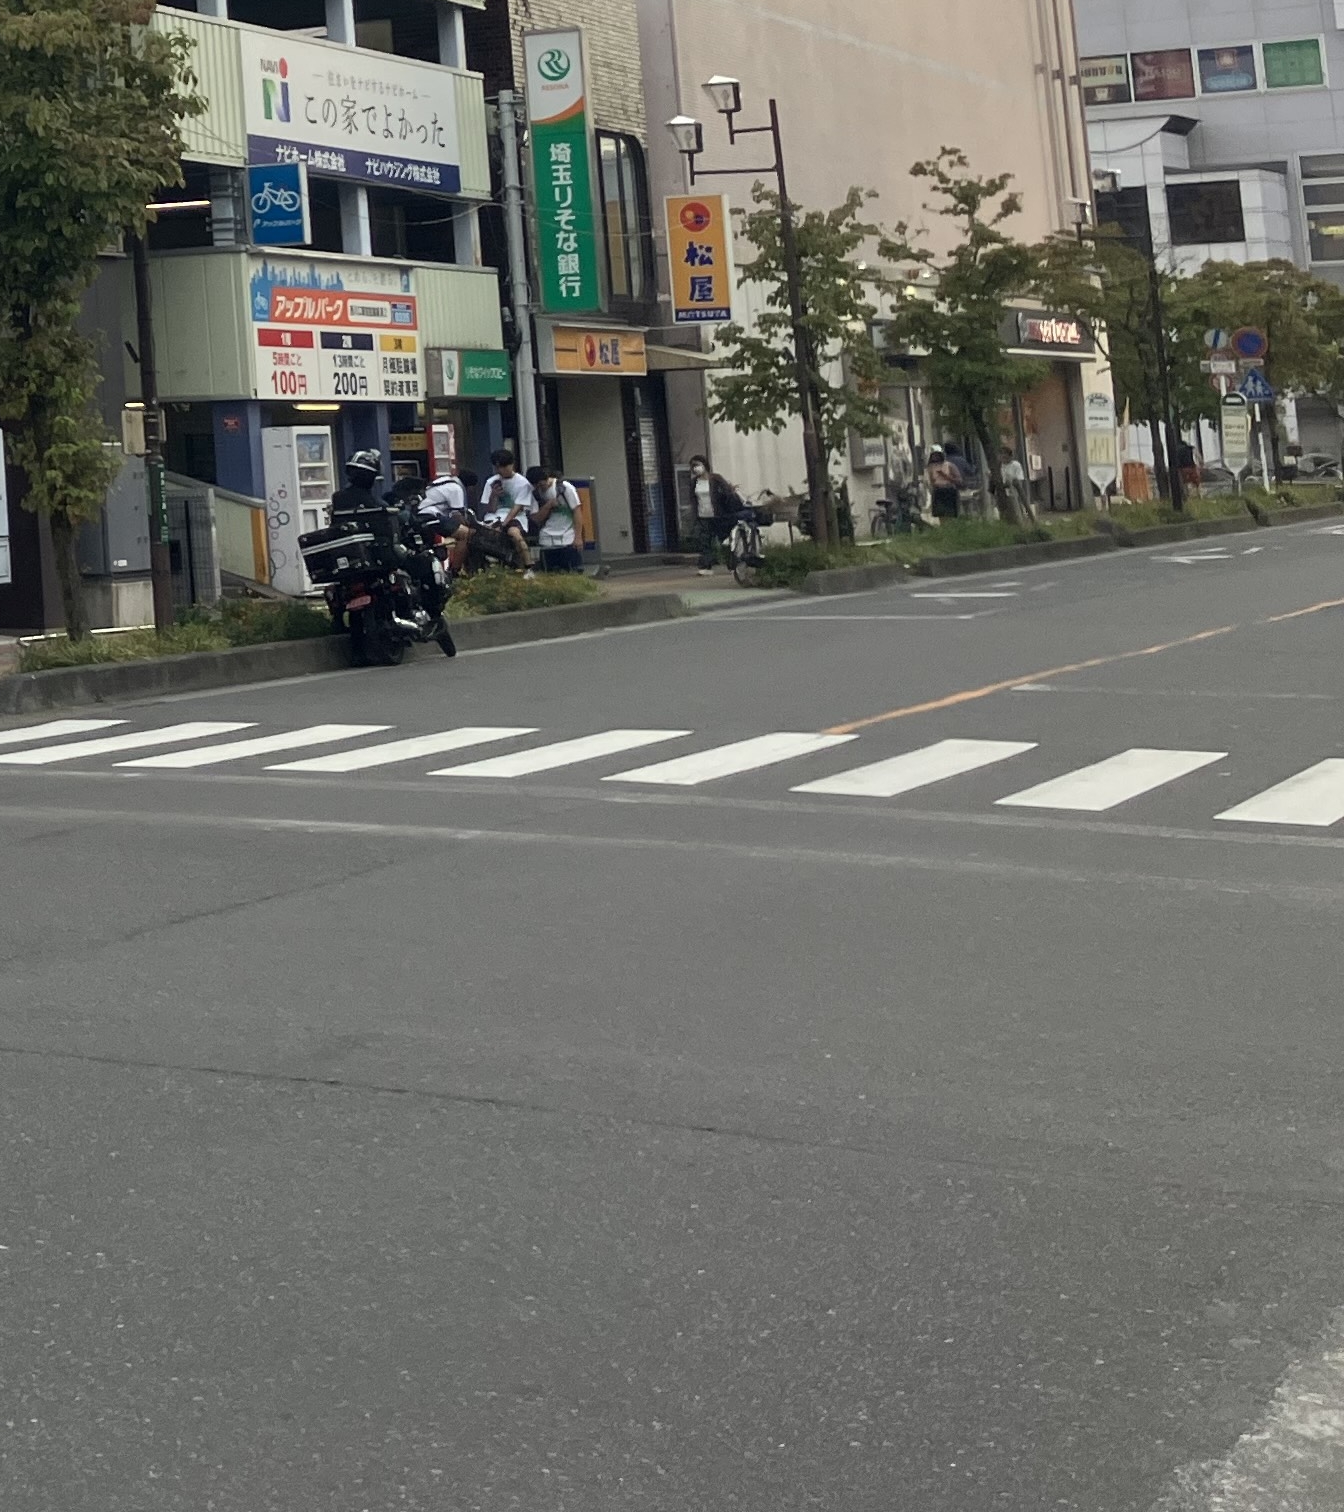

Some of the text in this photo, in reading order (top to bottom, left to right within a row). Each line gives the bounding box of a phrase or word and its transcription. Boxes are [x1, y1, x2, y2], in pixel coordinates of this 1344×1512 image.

[304, 94, 446, 148] この家でよかった
[275, 144, 347, 173] ナビホーム株式会社
[549, 142, 581, 298] 埼玉りそな銀行
[683, 241, 715, 302] 松屋
[274, 295, 344, 321] アップルパーク
[599, 338, 621, 366] 松屋
[271, 371, 308, 395] 100円
[333, 372, 368, 396] 200円
[383, 379, 419, 397] 契約者専用
